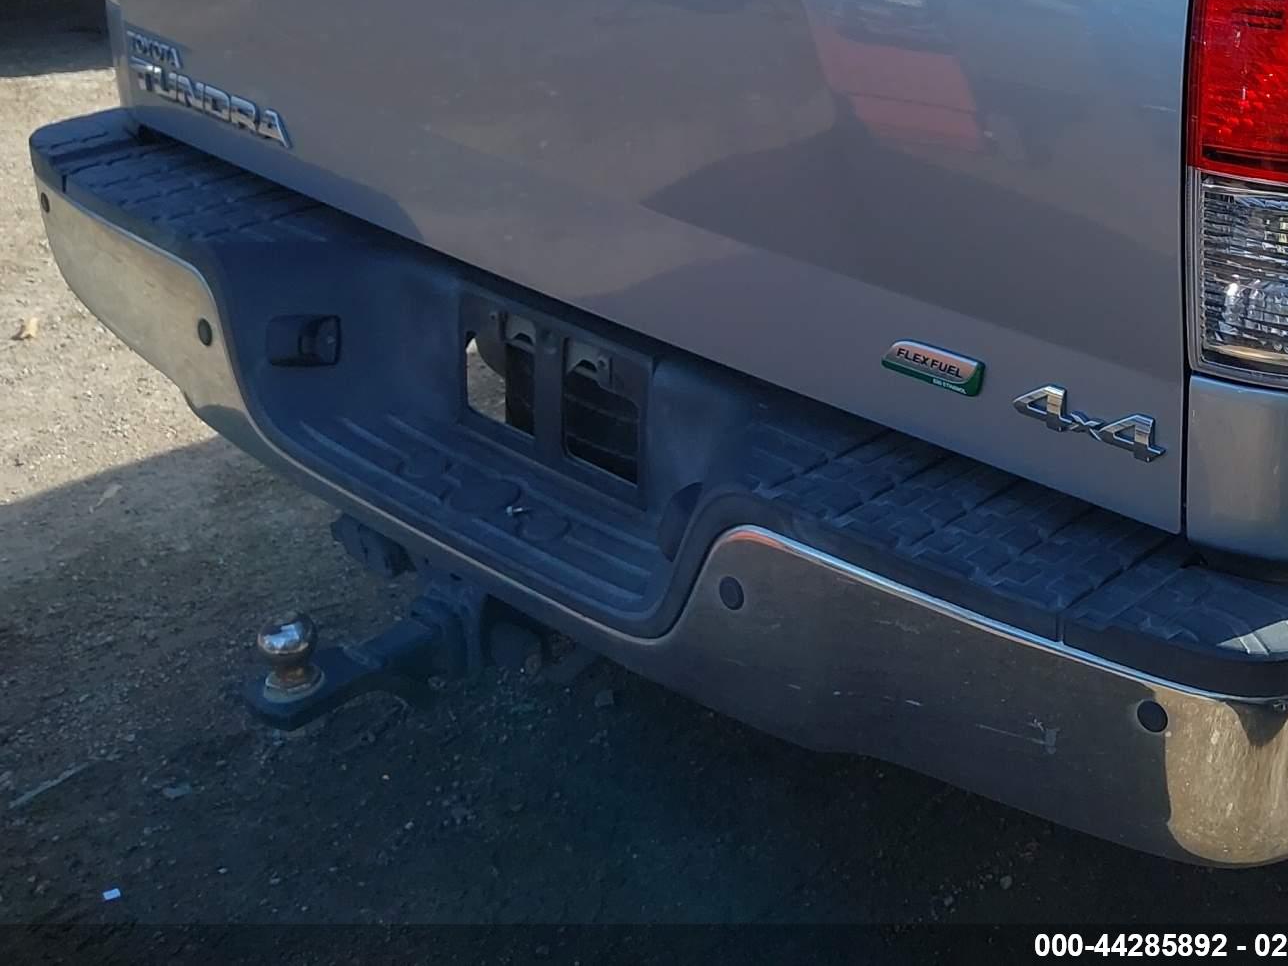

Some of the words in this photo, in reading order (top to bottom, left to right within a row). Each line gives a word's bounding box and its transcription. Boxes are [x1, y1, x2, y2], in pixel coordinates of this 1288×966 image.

[126, 29, 182, 70] TOYOTA
[130, 55, 293, 150] TUNDRA
[895, 347, 930, 367] FLEX
[930, 358, 963, 379] FUEL
